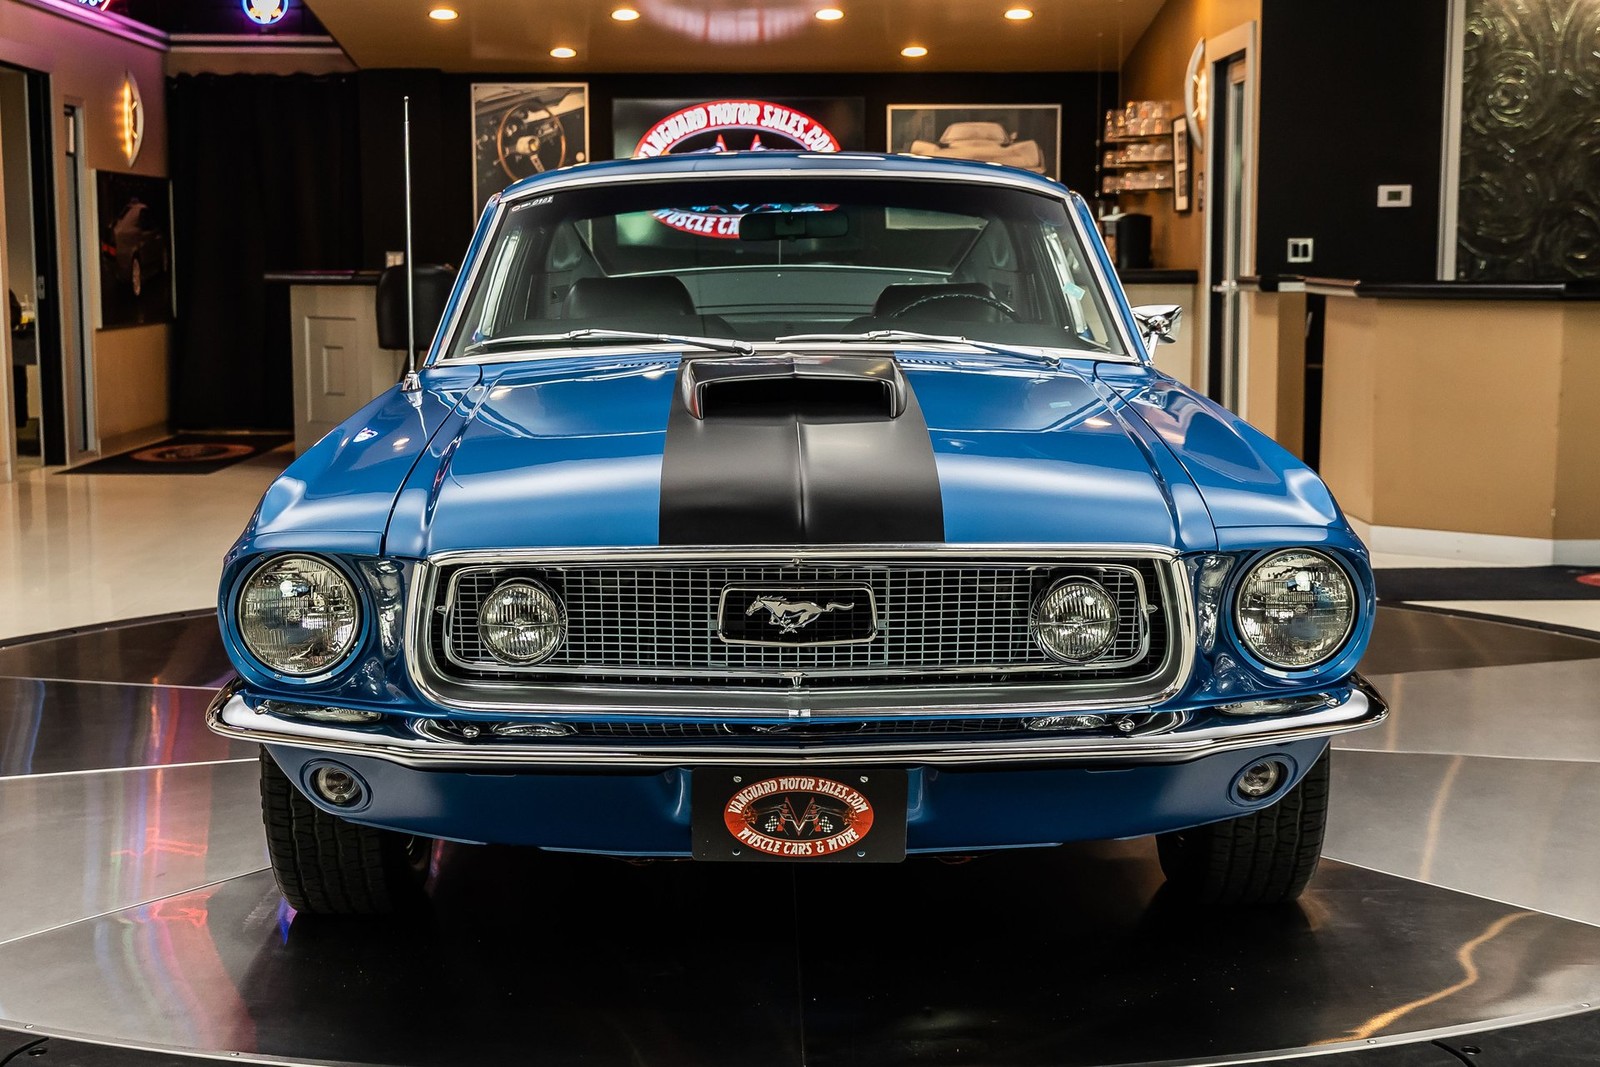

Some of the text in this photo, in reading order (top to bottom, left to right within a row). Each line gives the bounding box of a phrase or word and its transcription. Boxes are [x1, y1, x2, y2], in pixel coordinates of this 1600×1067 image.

[707, 102, 760, 127] MOTOR
[717, 217, 740, 235] CA
[728, 777, 869, 814] VANGUARD MOTOR SALES.COM
[737, 827, 859, 855] MUSCLE CARS & MORE
